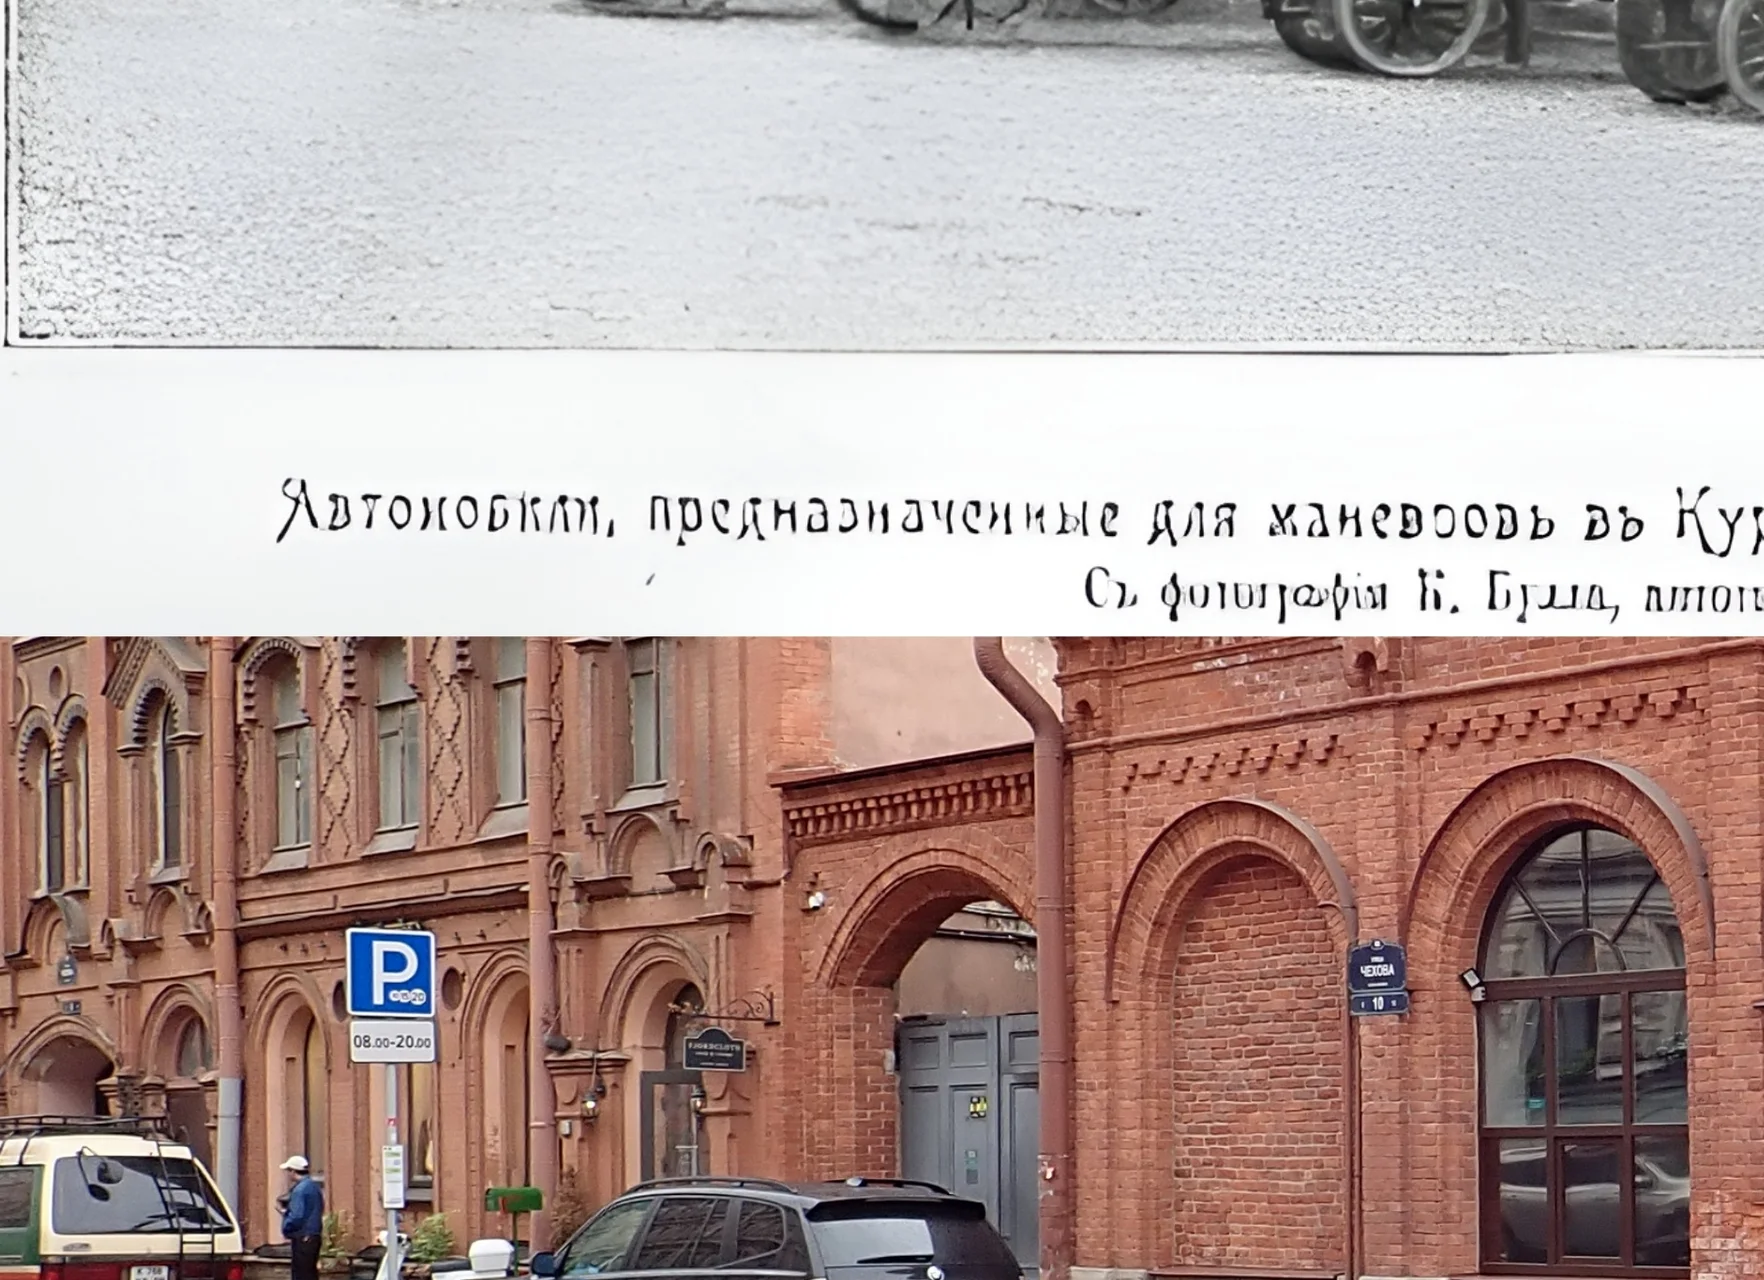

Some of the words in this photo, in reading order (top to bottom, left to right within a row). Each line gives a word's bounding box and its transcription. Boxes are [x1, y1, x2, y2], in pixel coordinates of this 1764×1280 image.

[1147, 500, 1237, 546] для
[1360, 964, 1395, 977] ЧЕХОВА
[1372, 996, 1384, 1011] 10
